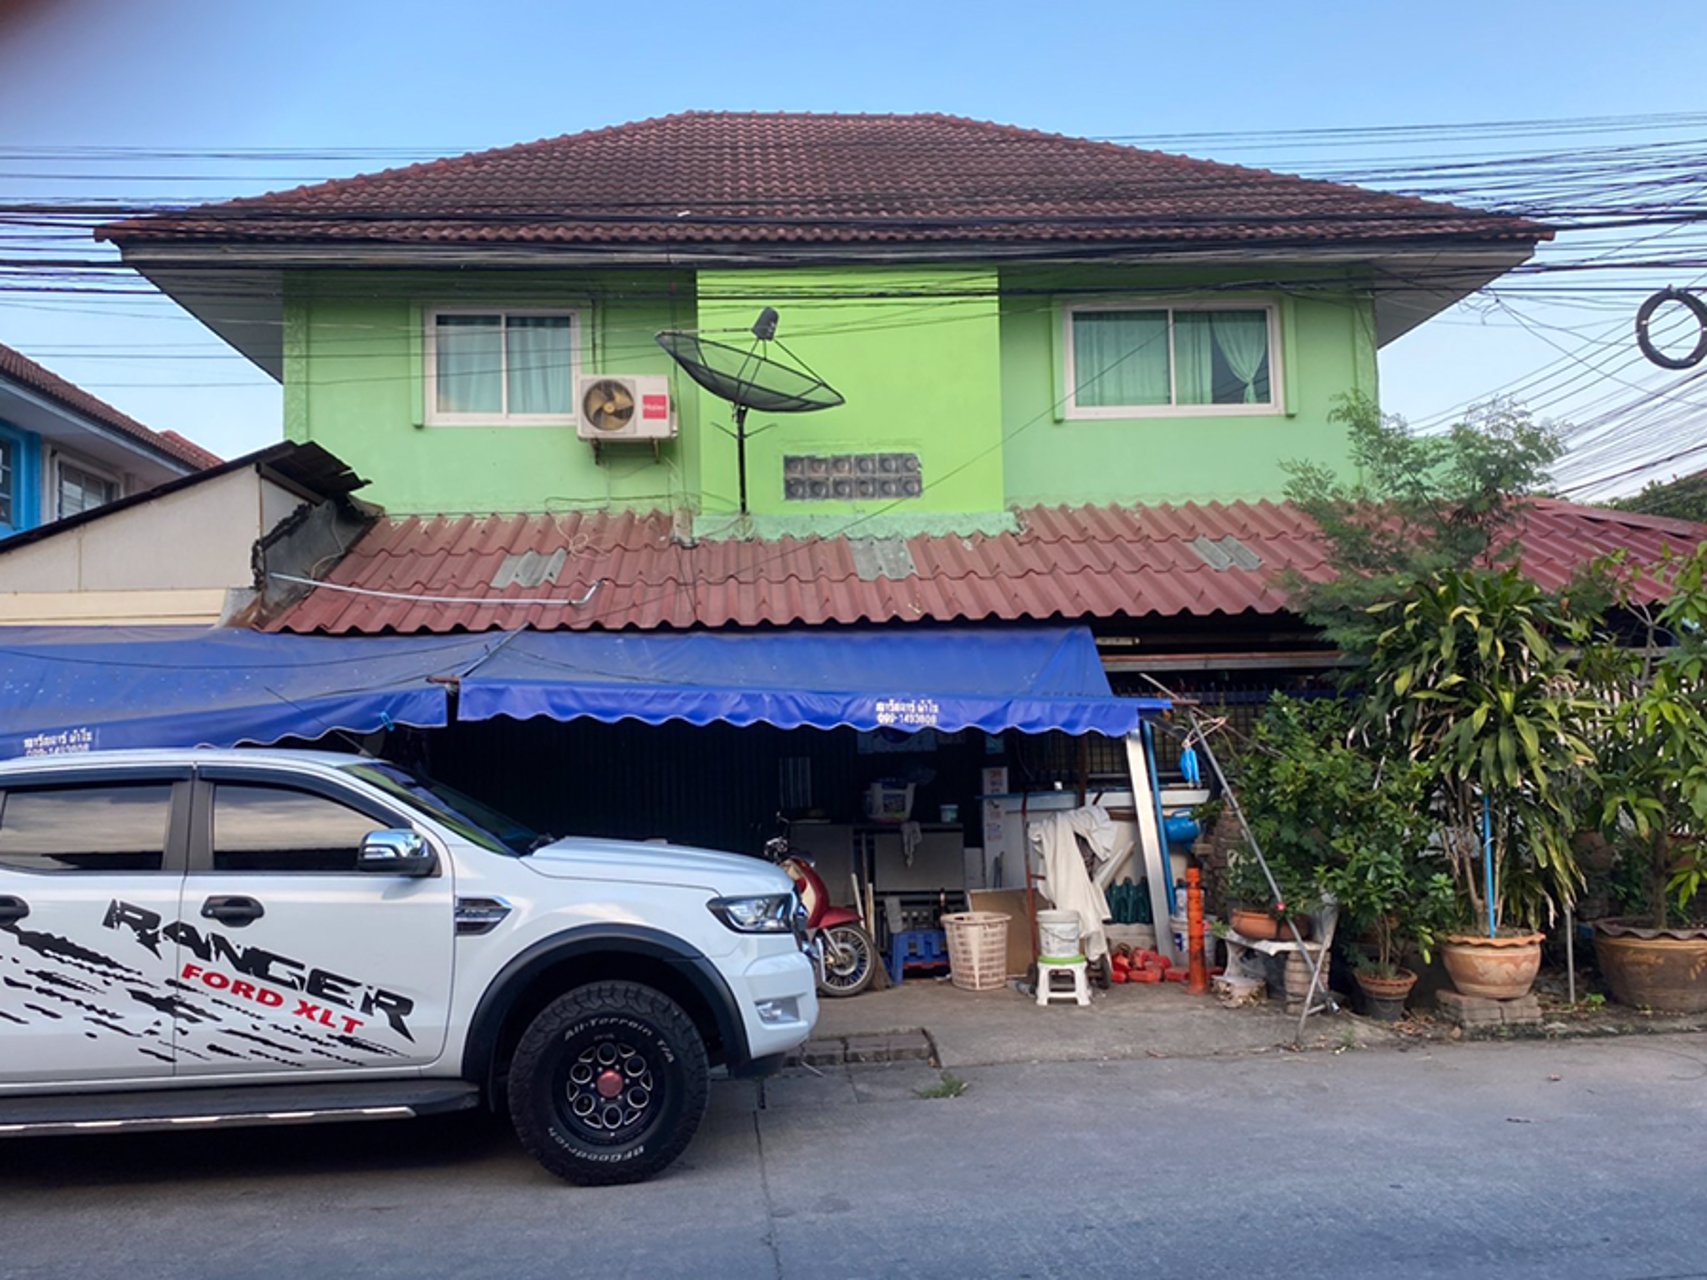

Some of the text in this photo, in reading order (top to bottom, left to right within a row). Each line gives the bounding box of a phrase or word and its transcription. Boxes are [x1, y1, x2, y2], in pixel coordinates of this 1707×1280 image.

[103, 898, 416, 1043] RANGER
[182, 964, 365, 1034] FORD XLT
